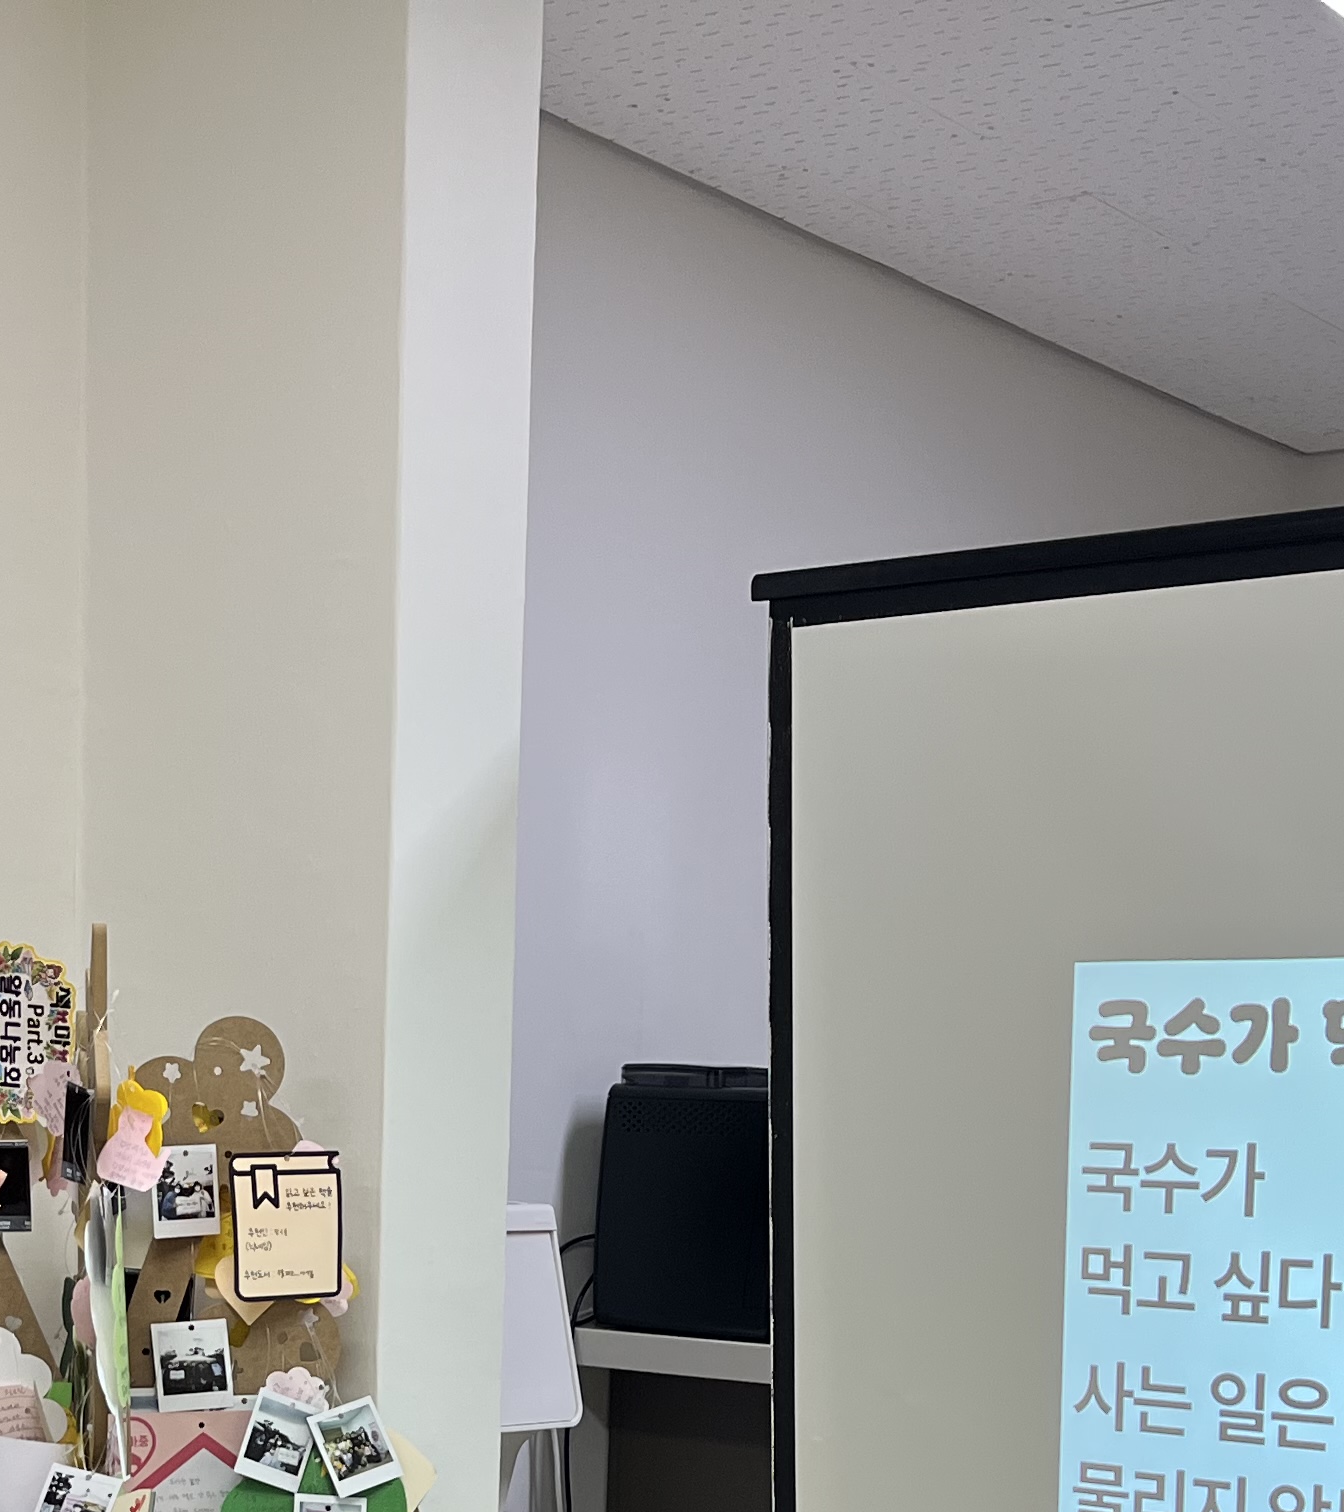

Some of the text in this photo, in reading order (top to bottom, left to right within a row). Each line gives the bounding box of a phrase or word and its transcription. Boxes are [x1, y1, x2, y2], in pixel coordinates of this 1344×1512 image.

[0, 974, 23, 1089] 활동나눔회
[26, 1004, 45, 1064] Part.3
[1087, 999, 1299, 1076] 국수가
[1081, 1142, 1267, 1217] 국수가
[1079, 1245, 1343, 1329] 먹고 싶다
[1072, 1361, 1194, 1435] 사는
[1208, 1371, 1335, 1452] 일은
